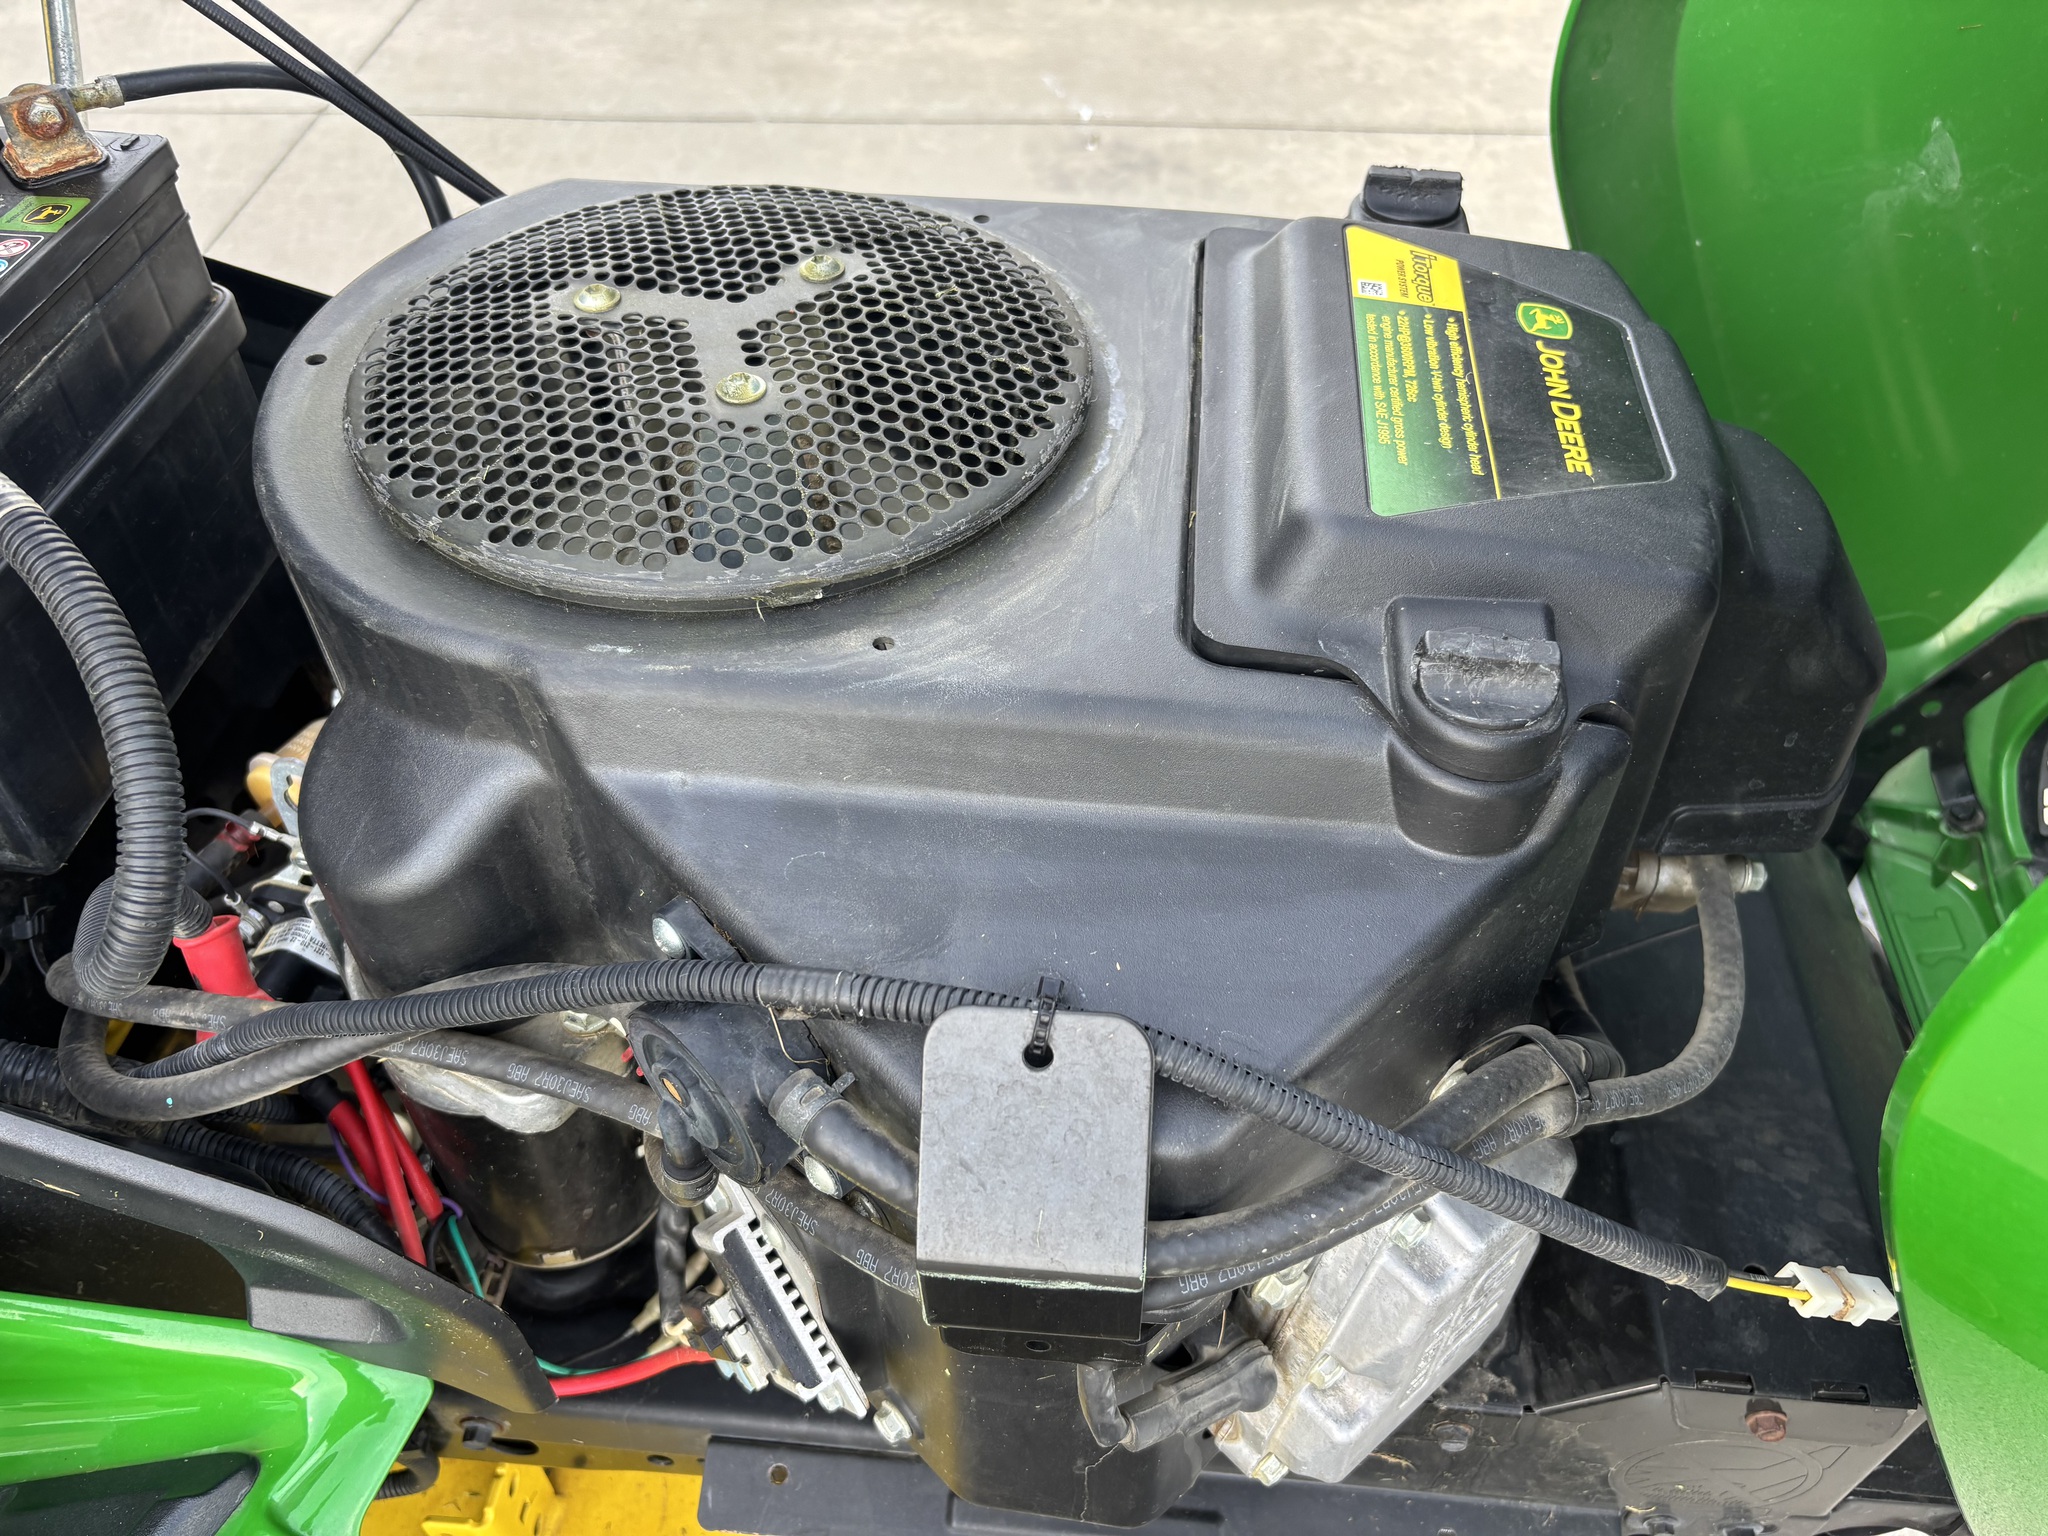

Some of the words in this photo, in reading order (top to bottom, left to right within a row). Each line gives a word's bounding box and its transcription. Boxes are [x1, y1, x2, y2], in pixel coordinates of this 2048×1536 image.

[1396, 259, 1406, 277] POWER
[1410, 250, 1437, 304] iTorque
[1398, 277, 1409, 298] SYSTEM
[1366, 314, 1377, 334] tested
[1380, 316, 1392, 339] engine
[1423, 320, 1434, 335] Low
[1445, 323, 1460, 340] High
[1369, 343, 1381, 383] accordance
[1385, 340, 1398, 386] manufacturer
[1426, 337, 1441, 369] vibration
[1449, 342, 1465, 378] efficiency
[1431, 371, 1444, 392] V-twin
[1536, 340, 1572, 399] JOHN
[1373, 385, 1384, 400] with
[1390, 387, 1404, 416] certified
[1405, 380, 1418, 402] 726cc
[1456, 378, 1473, 422] hemispheric
[1375, 401, 1386, 418] SAE
[1432, 393, 1449, 422] cylinder
[1377, 420, 1390, 444] J1995
[1391, 417, 1404, 438] gross
[1438, 423, 1452, 448] design
[1460, 423, 1478, 453] cylinder
[1550, 401, 1593, 476] DEERE
[1394, 440, 1407, 465] power
[1469, 454, 1485, 476] head
[411, 1039, 470, 1067] SAEJ30R7
[506, 1062, 531, 1083] ABG
[534, 1070, 592, 1103] SAEJ30R7
[627, 1103, 654, 1125] ABG
[1471, 1131, 1497, 1160] ABG
[765, 1188, 820, 1237] SAEJ30R7
[855, 1248, 879, 1274] ABG
[883, 1263, 919, 1293] 30R7
